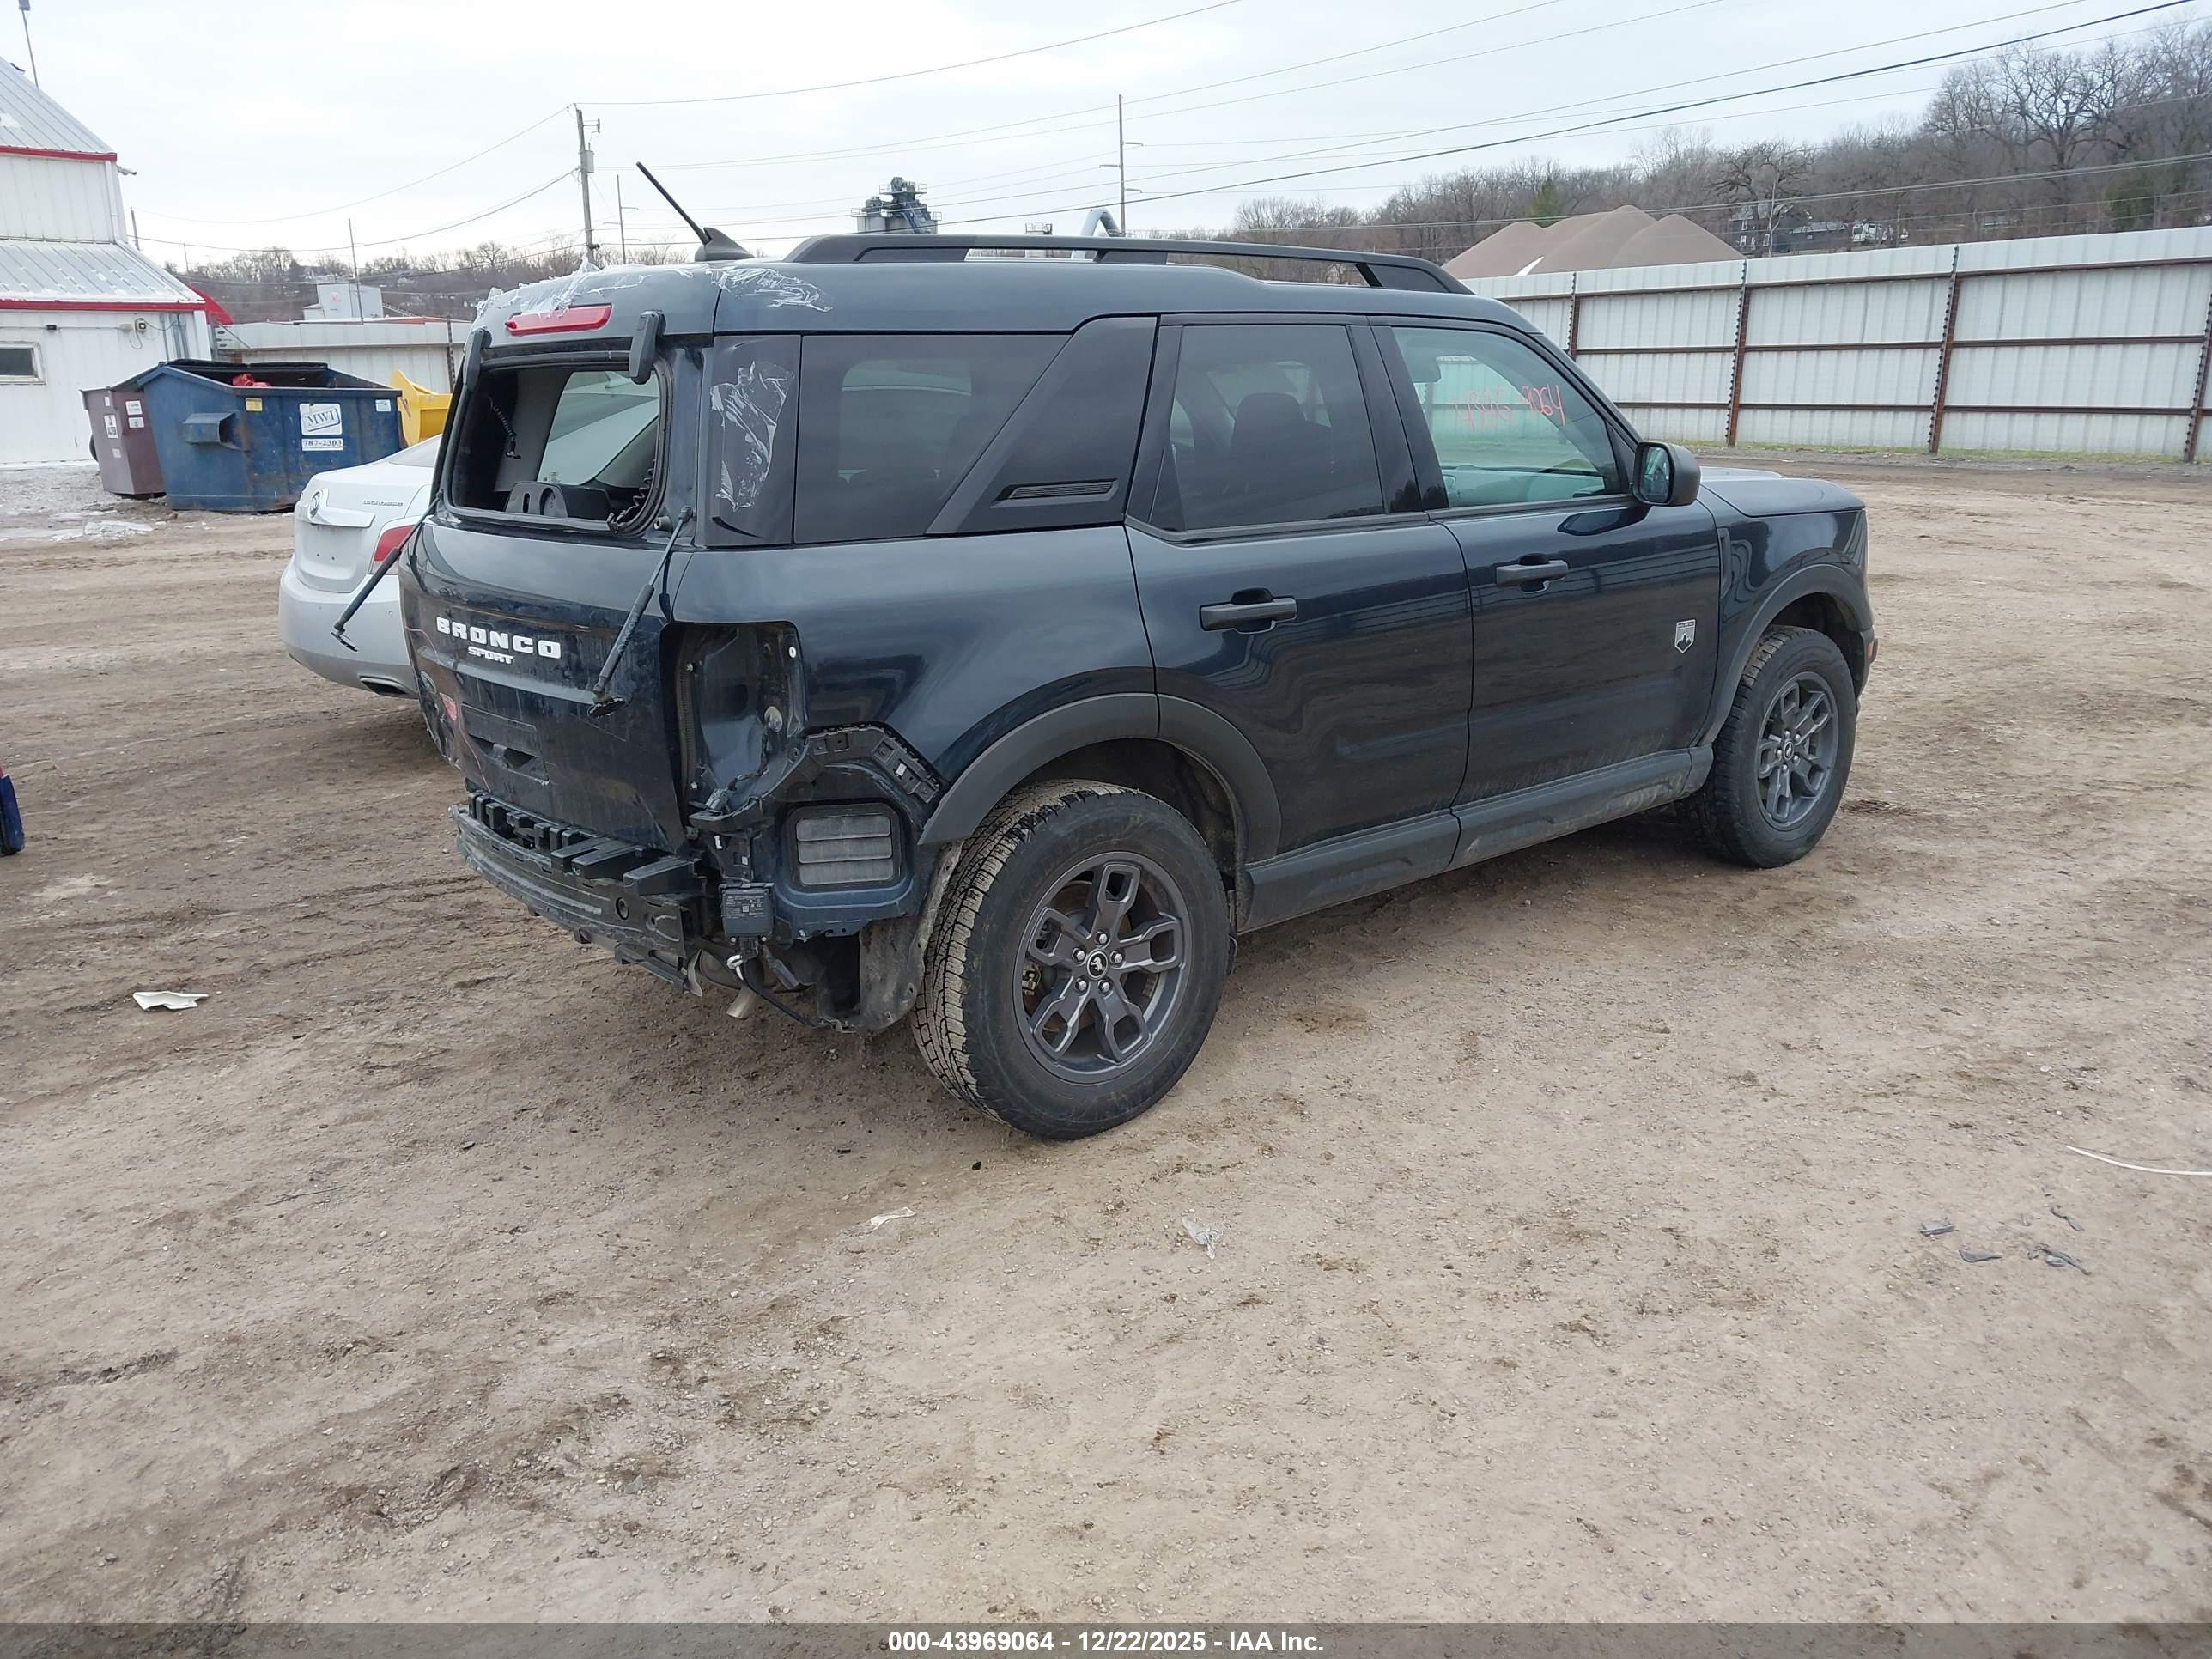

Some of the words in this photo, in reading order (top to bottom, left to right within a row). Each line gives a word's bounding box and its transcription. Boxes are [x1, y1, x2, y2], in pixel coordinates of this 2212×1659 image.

[307, 410, 336, 427] MWI
[435, 616, 562, 659] BRONCO
[466, 645, 514, 665] SPORT
